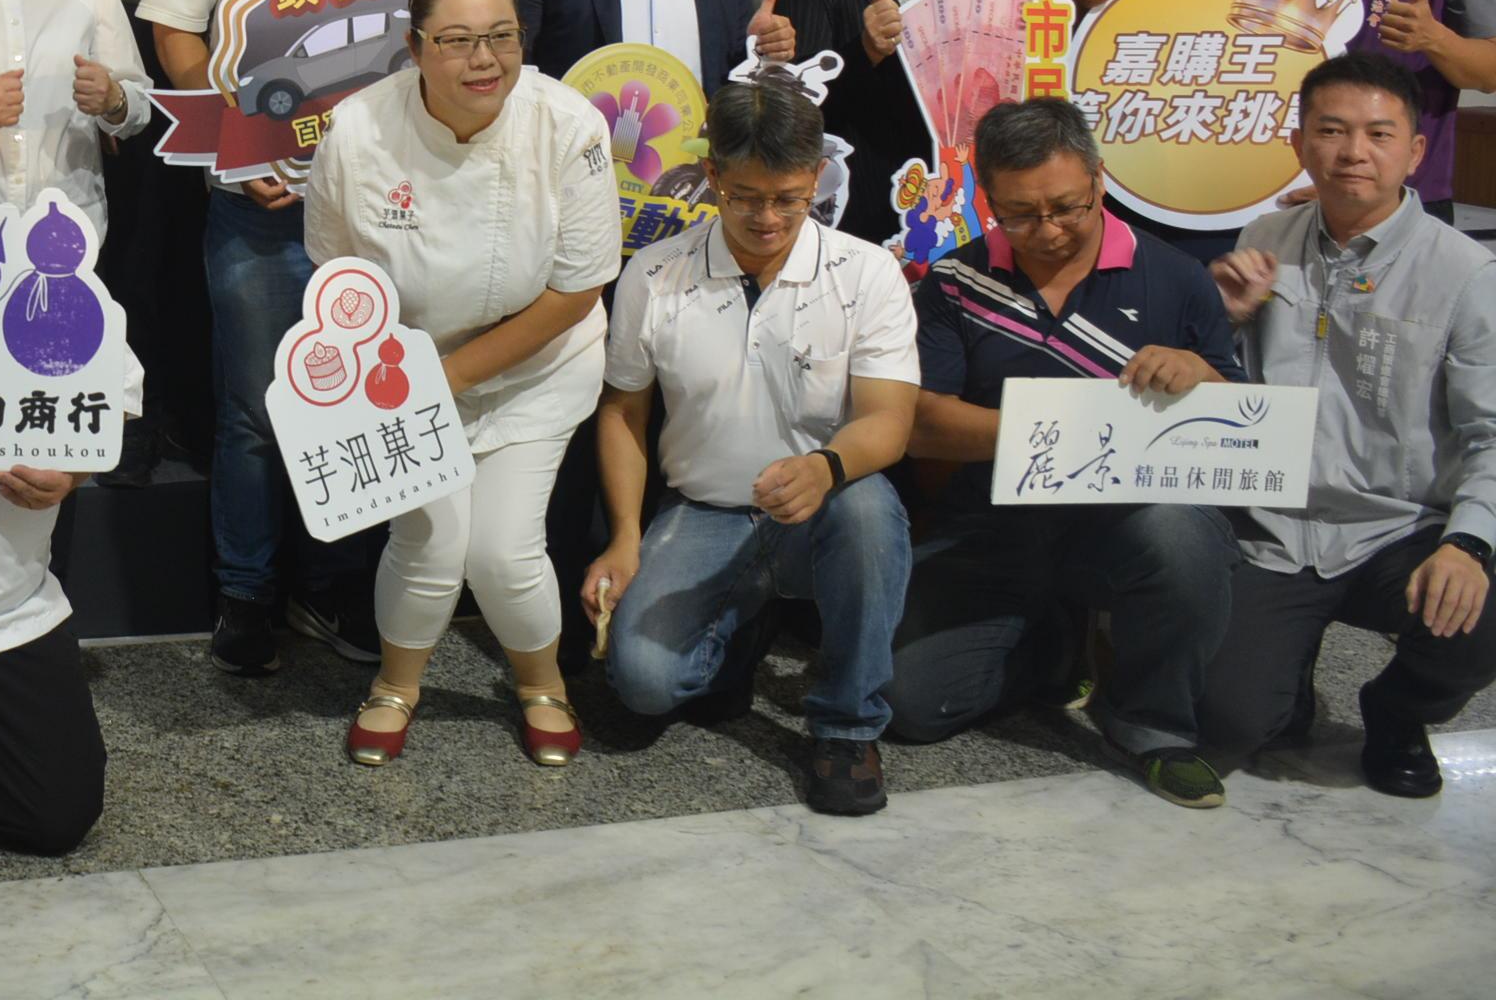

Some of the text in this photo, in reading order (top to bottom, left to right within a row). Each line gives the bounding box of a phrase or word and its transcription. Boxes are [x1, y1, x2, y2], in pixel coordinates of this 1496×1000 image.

[1102, 33, 1286, 86] 嘉購王
[620, 181, 645, 193] CITY
[1201, 436, 1218, 448] Spa
[1221, 437, 1259, 449] MOTEL
[1134, 464, 1286, 493] 精品休閒旅館
[323, 467, 460, 528] Imodagashi
